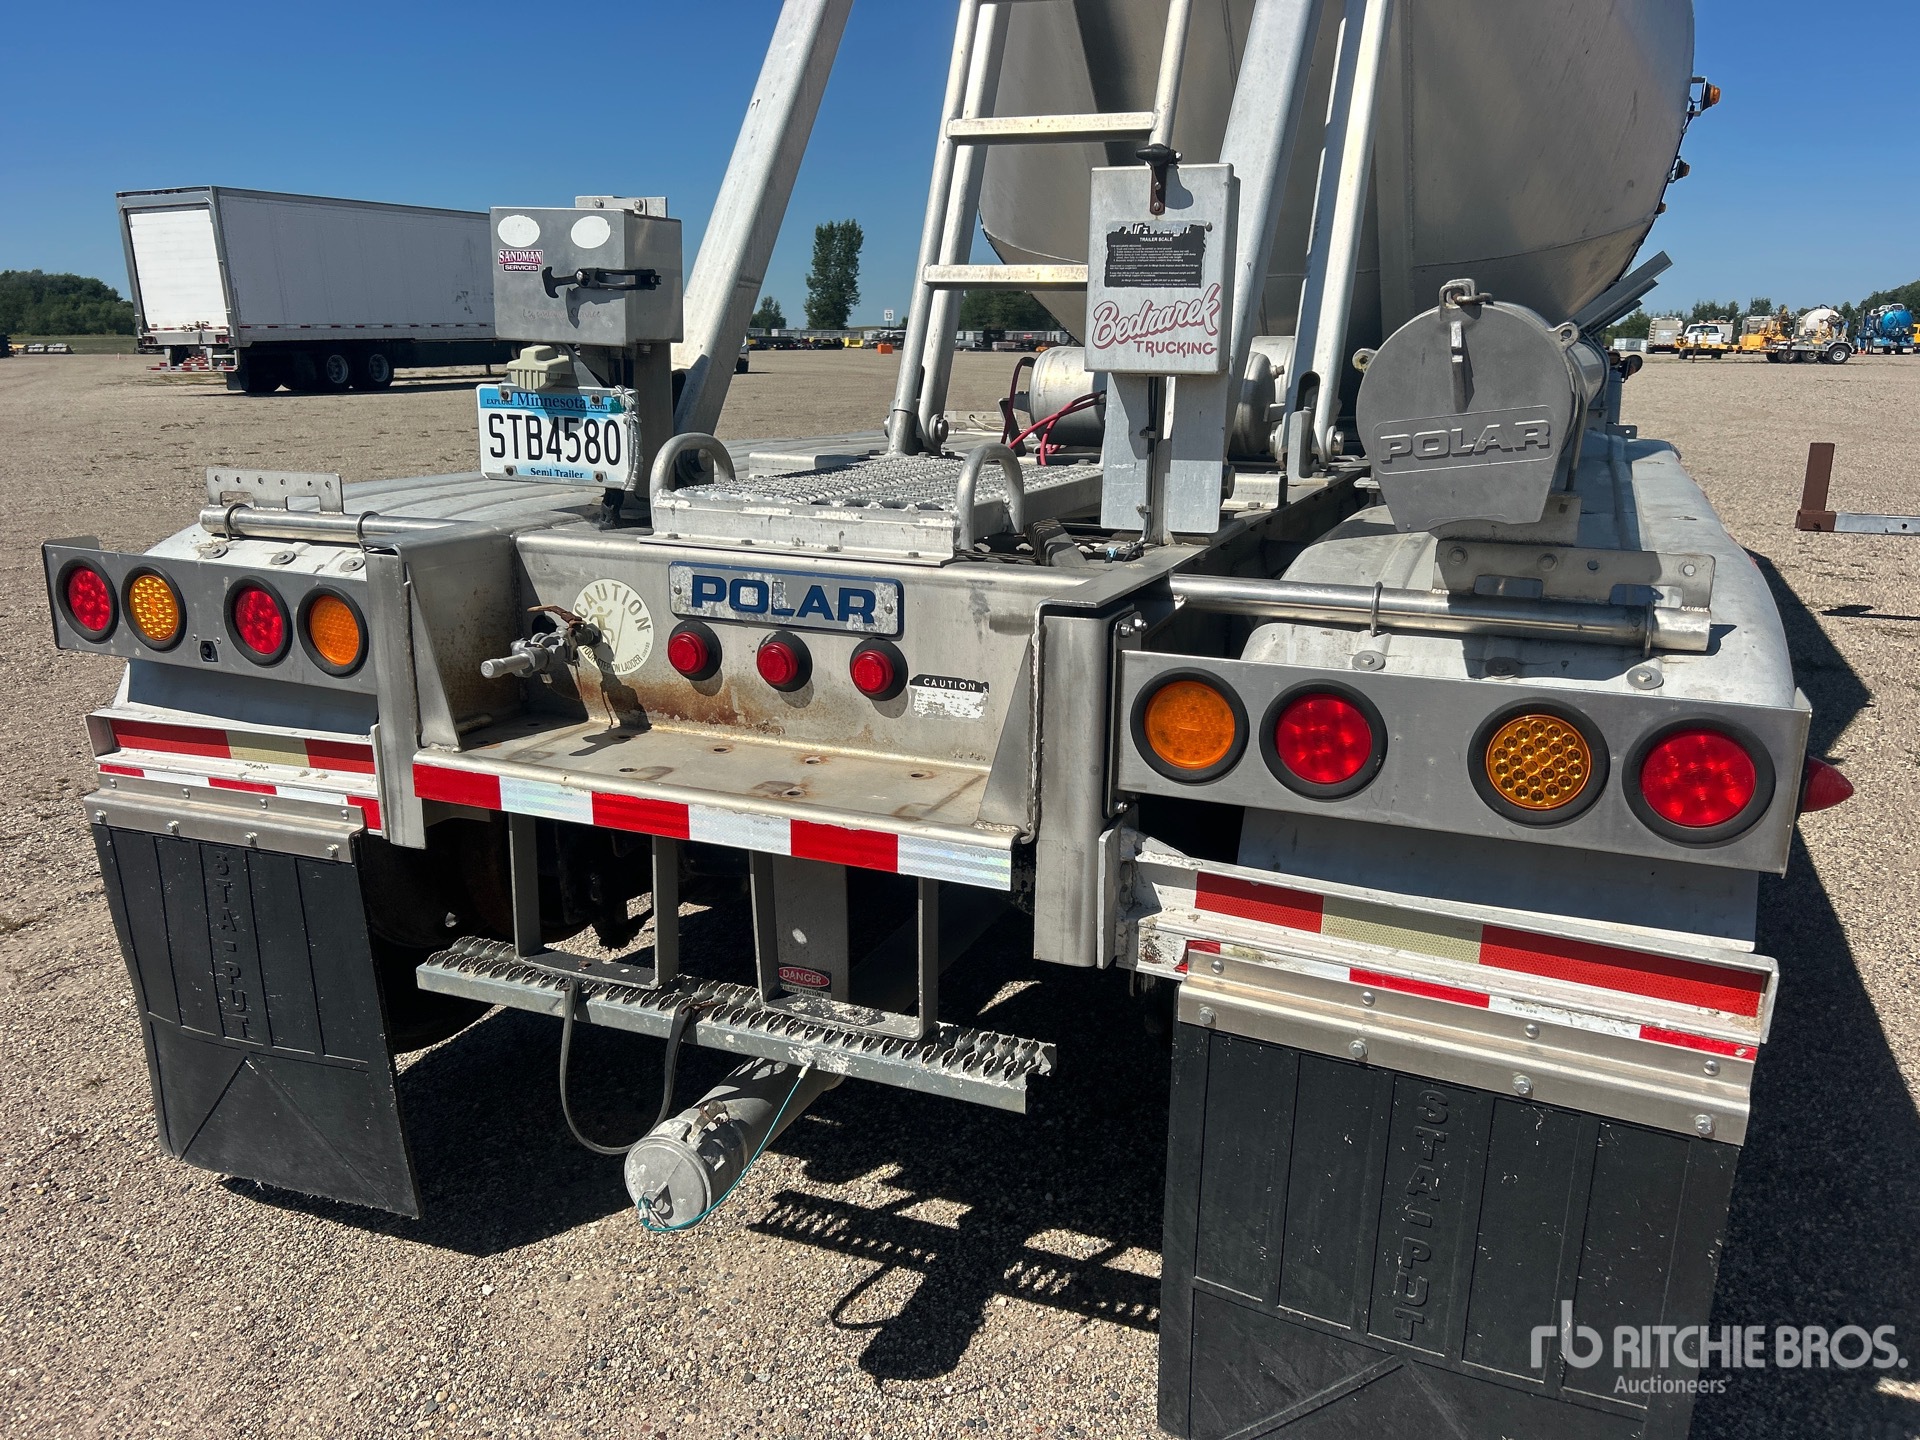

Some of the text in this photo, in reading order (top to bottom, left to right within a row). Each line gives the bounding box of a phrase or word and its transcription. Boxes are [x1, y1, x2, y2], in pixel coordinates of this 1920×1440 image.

[499, 250, 543, 265] SANDMAN
[1092, 283, 1221, 349] Bednarek
[1133, 341, 1218, 358] TRUCKING
[488, 413, 621, 465] STB4580
[1380, 419, 1551, 464] POLAR
[530, 467, 584, 479] Semi Trailer
[574, 583, 652, 632] CAUTION
[691, 574, 876, 624] POLAR
[621, 654, 643, 672] LADDER
[923, 678, 976, 691] CAUTION
[782, 969, 822, 985] DANGER
